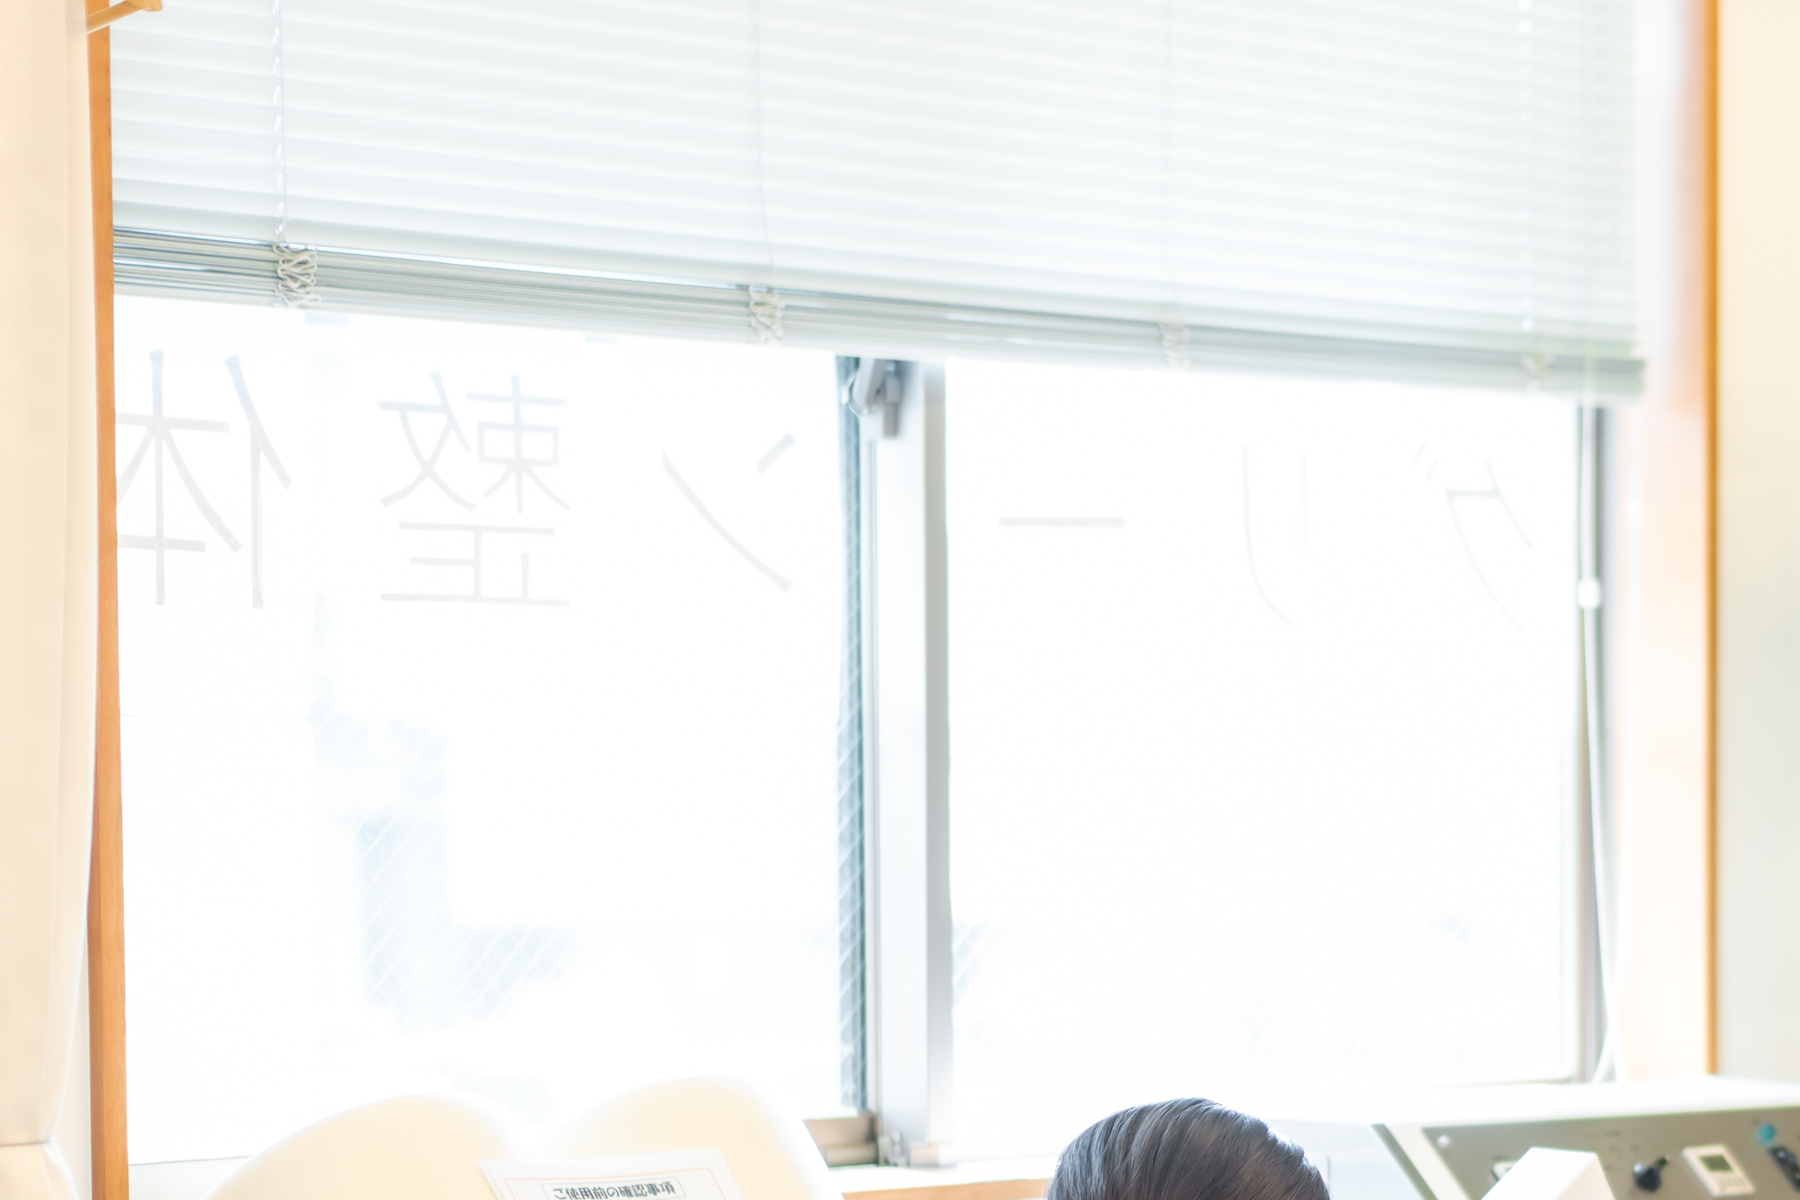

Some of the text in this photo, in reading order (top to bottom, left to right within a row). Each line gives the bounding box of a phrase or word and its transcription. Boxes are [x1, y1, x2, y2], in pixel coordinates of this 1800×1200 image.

[552, 1181, 677, 1200] ご使用前の確認事項
